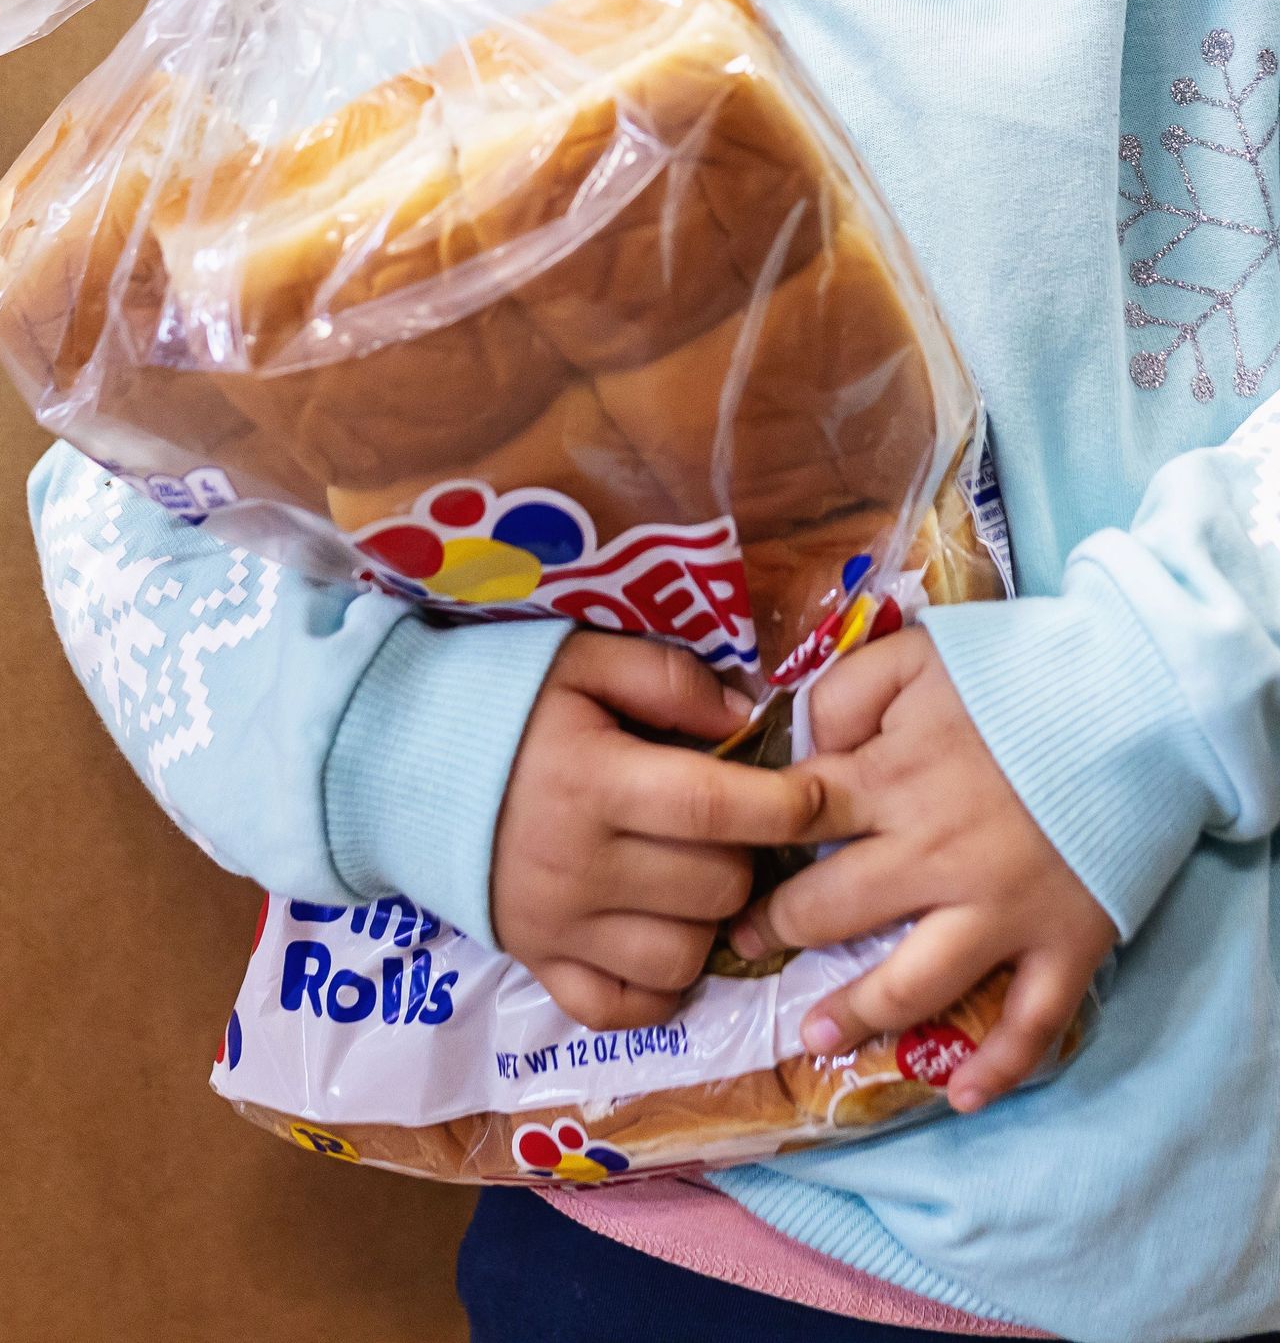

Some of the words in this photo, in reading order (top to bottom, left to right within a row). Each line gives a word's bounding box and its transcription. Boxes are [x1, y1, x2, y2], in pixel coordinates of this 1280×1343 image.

[280, 939, 459, 1025] Rolls
[496, 1051, 520, 1080] NET
[524, 1043, 560, 1075] WT
[566, 1038, 590, 1068] 12
[593, 1032, 621, 1063] OZ
